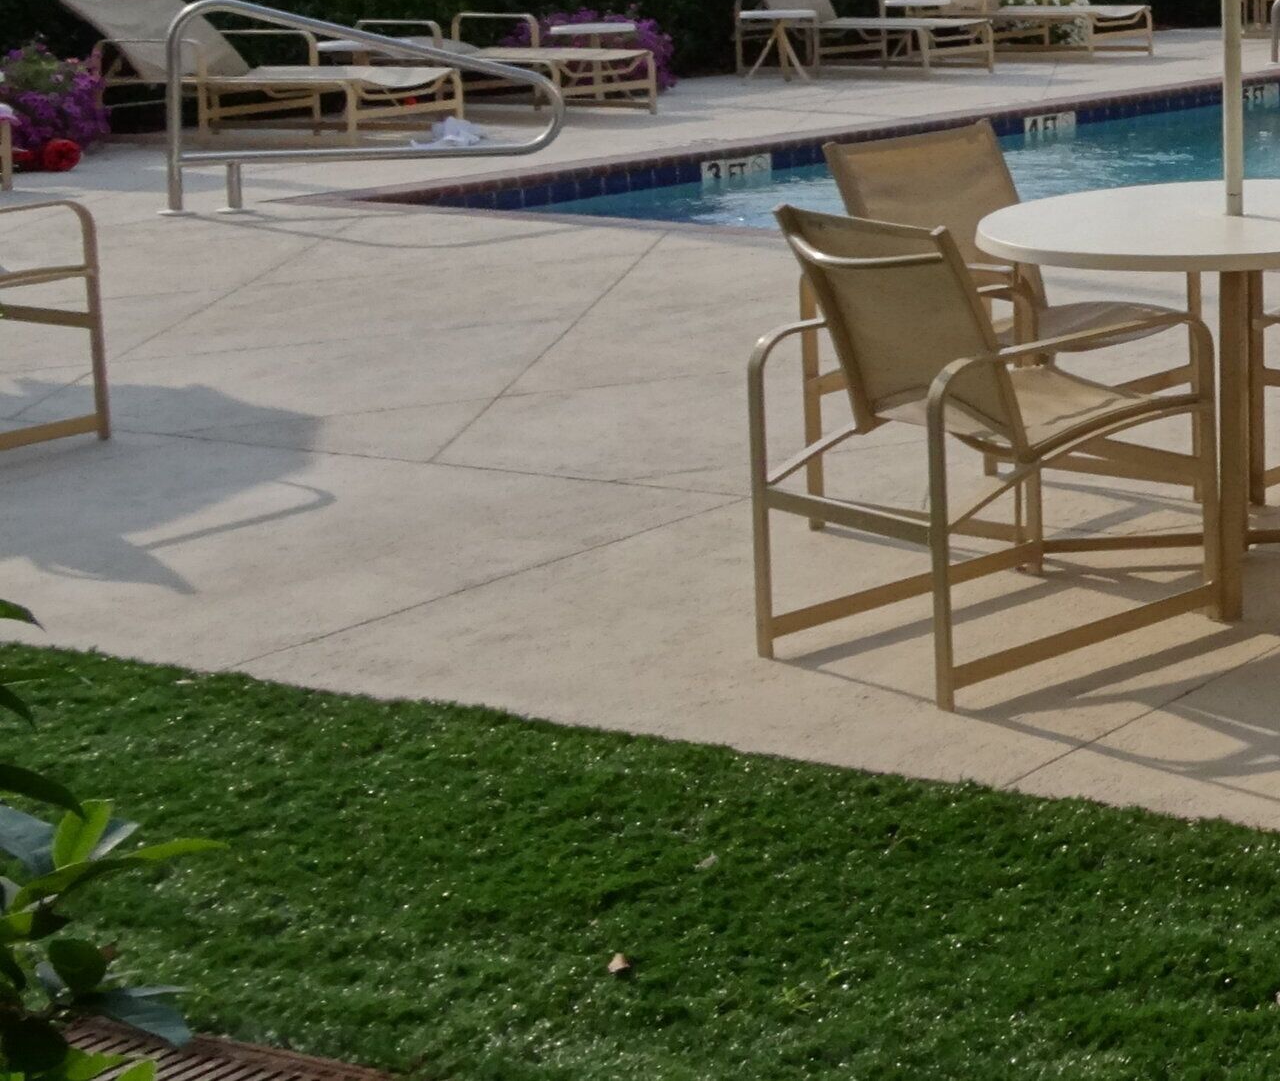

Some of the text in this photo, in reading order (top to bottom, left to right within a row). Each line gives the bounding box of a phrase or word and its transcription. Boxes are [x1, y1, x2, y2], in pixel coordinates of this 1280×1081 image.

[1253, 86, 1265, 102] FT
[1043, 115, 1057, 132] FT
[729, 162, 747, 178] FT
